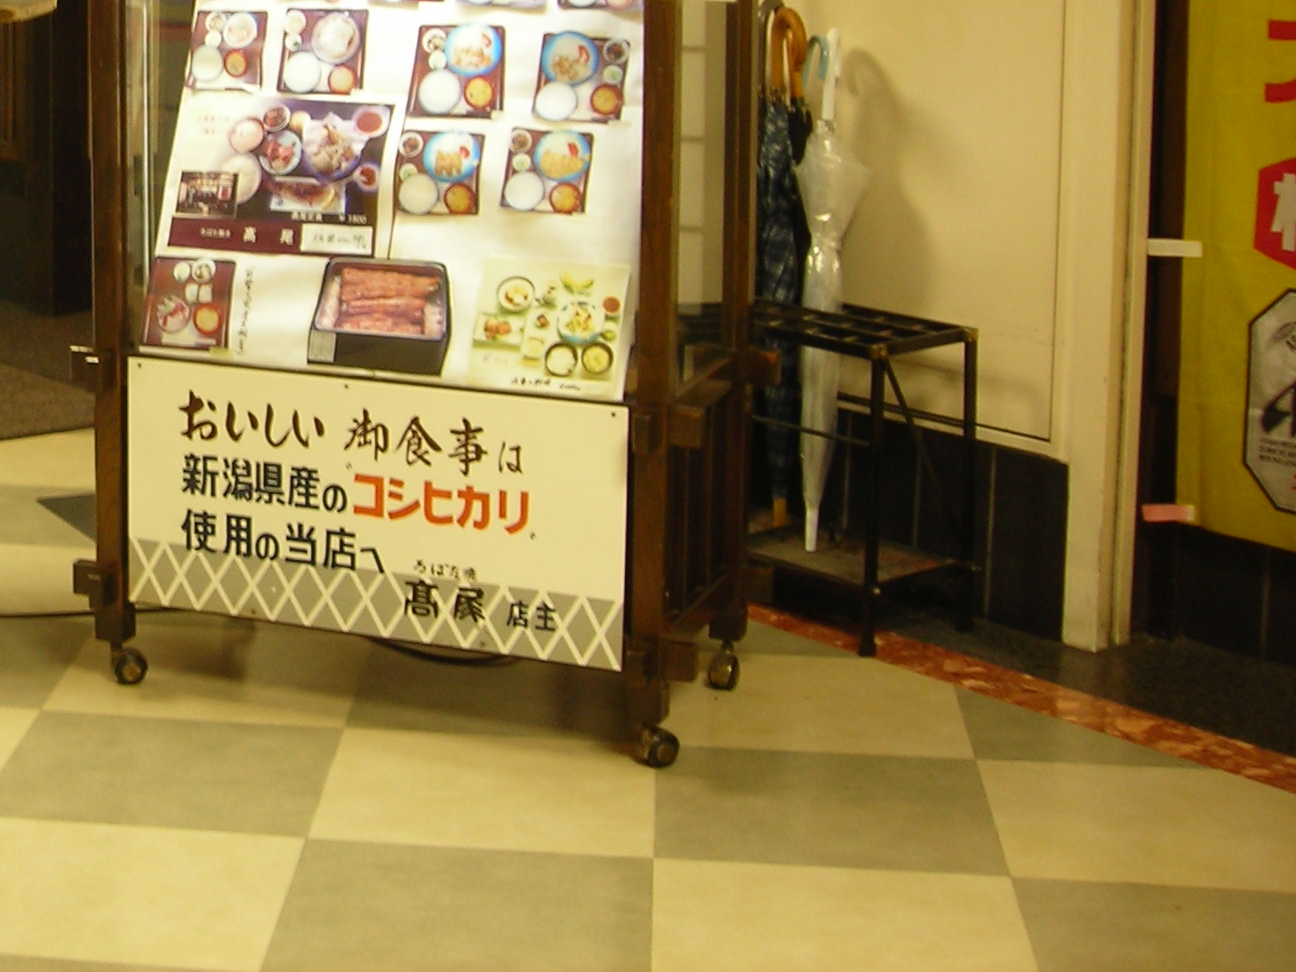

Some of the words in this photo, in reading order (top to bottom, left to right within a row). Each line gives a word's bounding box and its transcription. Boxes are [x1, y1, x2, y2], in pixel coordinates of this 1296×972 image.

[178, 388, 326, 449] おいしい
[344, 407, 525, 477] 御食事は
[181, 508, 386, 575] 使用の当店へ
[506, 600, 556, 632] 店主
